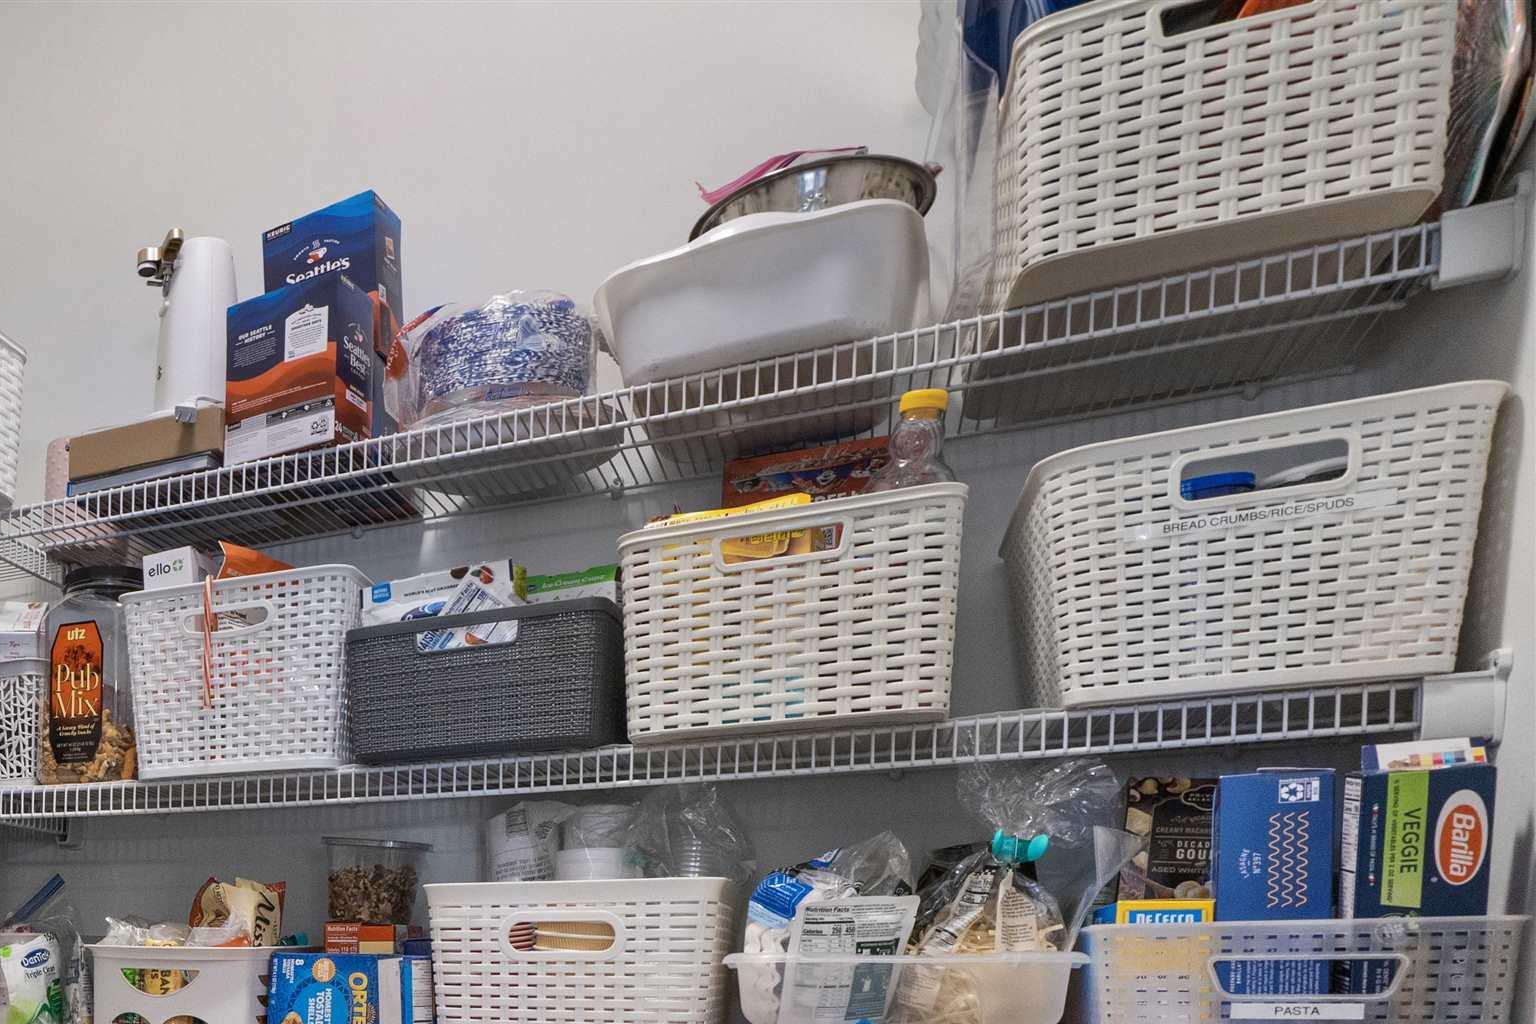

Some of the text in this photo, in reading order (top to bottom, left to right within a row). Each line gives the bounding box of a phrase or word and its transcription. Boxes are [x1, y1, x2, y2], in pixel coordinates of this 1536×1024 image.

[285, 257, 352, 286] Seattle's
[1162, 496, 1355, 535] BREAD CRUMBS/RICE/SPUDS
[148, 561, 172, 579] ello
[56, 663, 100, 693] Pub
[55, 690, 100, 719] Mix
[1399, 807, 1422, 874] VEGGIE
[1449, 812, 1476, 877] Barilla
[25, 969, 43, 980] Triple
[1274, 1006, 1321, 1016] PASTA
